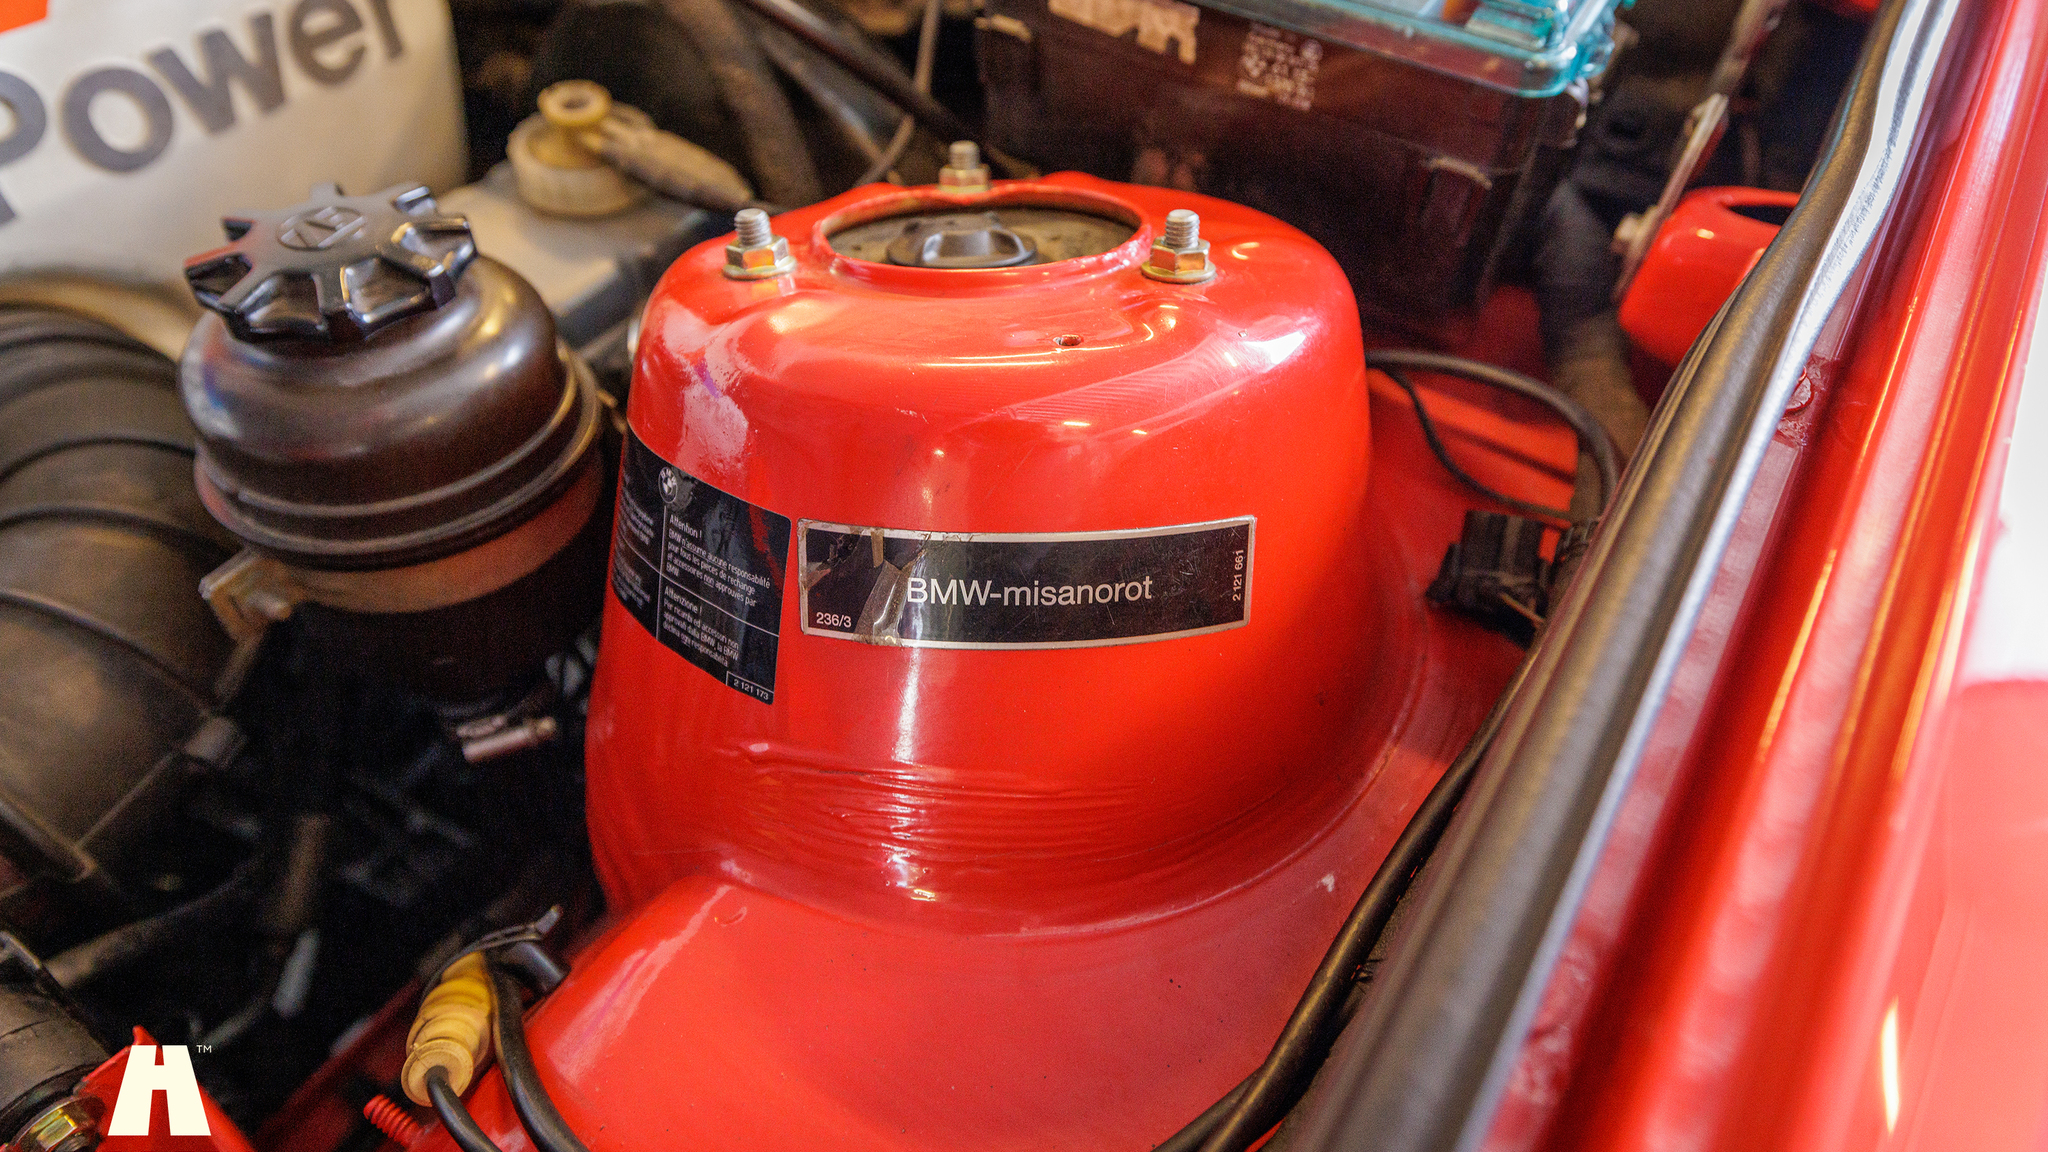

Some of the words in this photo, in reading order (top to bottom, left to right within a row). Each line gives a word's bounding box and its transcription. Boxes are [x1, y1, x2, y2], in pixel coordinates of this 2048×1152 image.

[666, 561, 680, 577] BMW
[668, 528, 681, 544] BMW
[728, 563, 771, 589] responsabilité
[1234, 549, 1244, 571] 661
[703, 574, 714, 587] non
[744, 596, 757, 607] par
[719, 569, 727, 581] de
[727, 575, 756, 596] rechange
[907, 575, 1153, 606] BMW-misanorot
[1232, 573, 1243, 592] 121
[664, 585, 698, 614] Attenzione
[1232, 593, 1242, 602] 2
[816, 611, 852, 628] 236/3
[723, 645, 739, 661] BMW
[727, 638, 739, 651] non
[733, 678, 739, 687] 2
[741, 681, 754, 694] 121
[756, 688, 769, 700] 173
